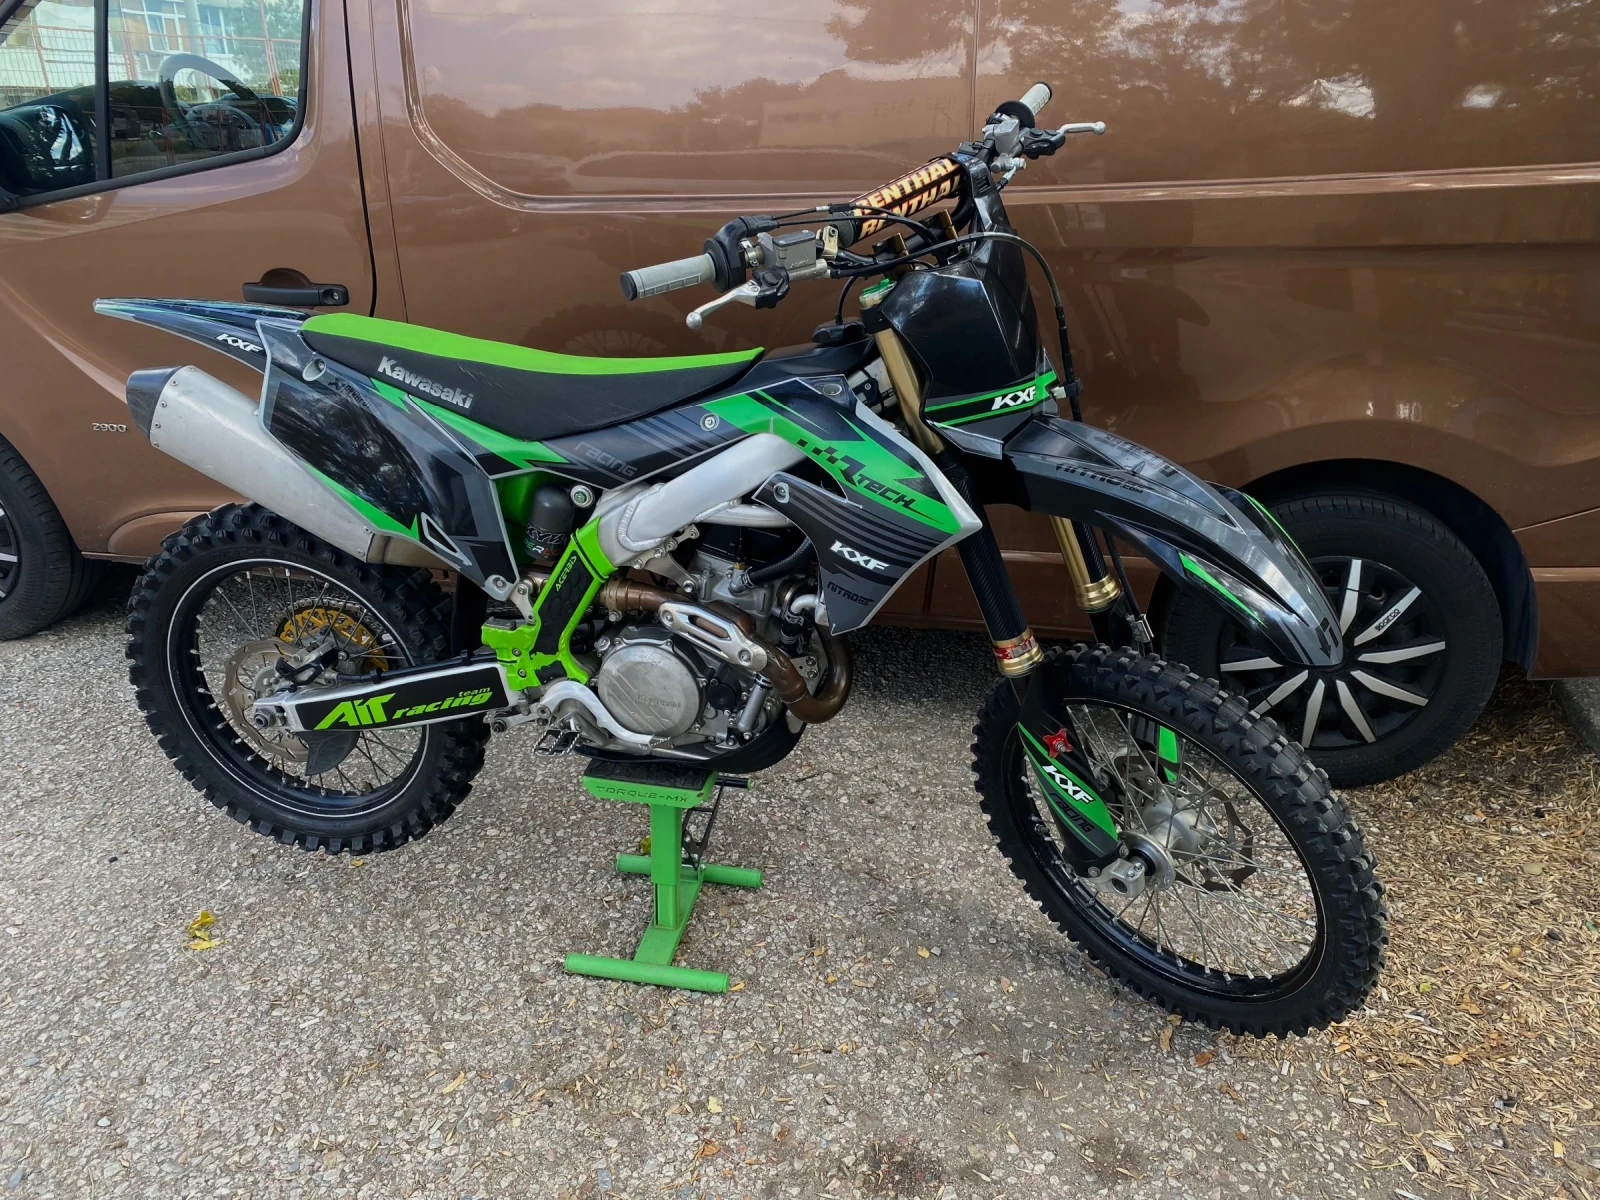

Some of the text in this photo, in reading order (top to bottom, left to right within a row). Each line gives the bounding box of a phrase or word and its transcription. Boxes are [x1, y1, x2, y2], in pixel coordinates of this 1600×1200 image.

[853, 158, 959, 216] RENTHAL
[860, 174, 960, 238] RNTHAL
[216, 333, 265, 352] KXF
[377, 356, 474, 410] Kawasaki
[991, 386, 1037, 410] KXF
[92, 422, 126, 433] 2900
[829, 539, 890, 570] KXF
[555, 555, 577, 592] ACERBIS
[392, 691, 493, 720] racing
[458, 687, 490, 698] team
[596, 785, 688, 803] TORQUE-MX
[1041, 765, 1094, 803] KXF
